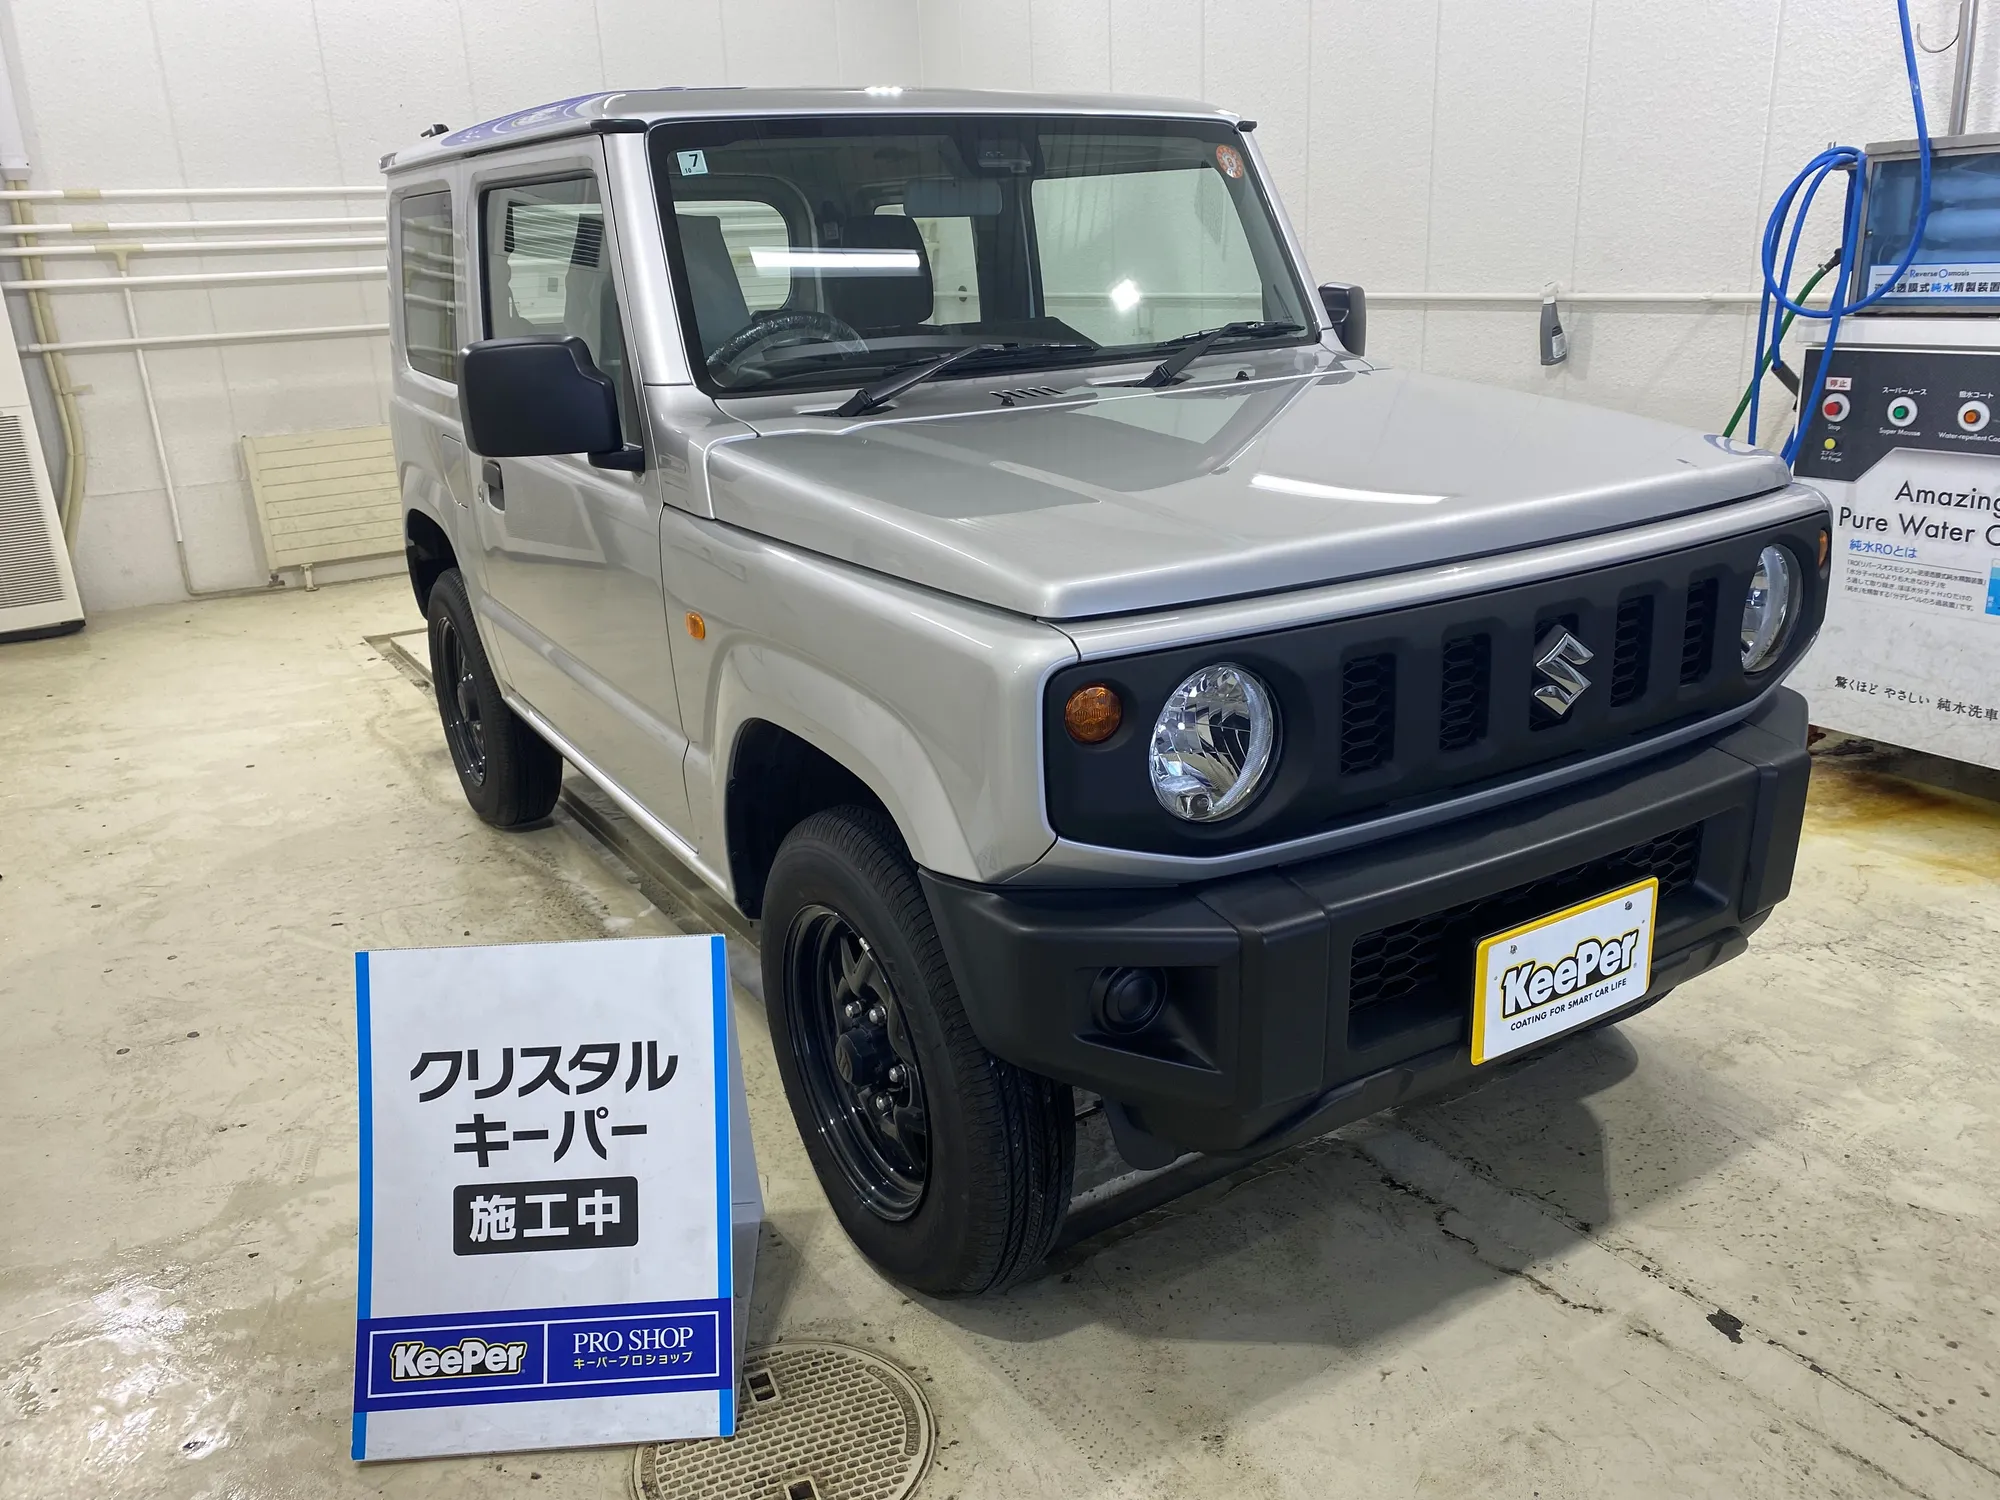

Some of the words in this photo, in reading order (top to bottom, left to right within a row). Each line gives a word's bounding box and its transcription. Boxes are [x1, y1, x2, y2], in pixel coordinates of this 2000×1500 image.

[689, 154, 698, 167] 7
[1909, 269, 1938, 278] Reverse
[1838, 506, 1888, 532] Pure
[1899, 513, 1976, 543] Water
[1849, 538, 1917, 559] 純水ROとは
[1834, 675, 1879, 695] 驚くほど
[1884, 687, 1930, 704] やさしい
[1936, 697, 1999, 721] 純水洗車
[1502, 929, 1639, 1019] KeePer
[1510, 1011, 1547, 1031] COATING
[1549, 1003, 1566, 1017] FOR
[1567, 992, 1593, 1010] SMART
[1594, 985, 1609, 998] CAR
[1610, 977, 1627, 992] LIFE
[410, 1040, 679, 1102] クリスタル
[453, 1106, 648, 1168] キーパー
[469, 1189, 622, 1241] 施工中
[390, 1338, 528, 1381] KeePer
[572, 1331, 623, 1354] PRO
[628, 1326, 694, 1351] SHOP
[573, 1351, 694, 1370] キーパープロショップ
